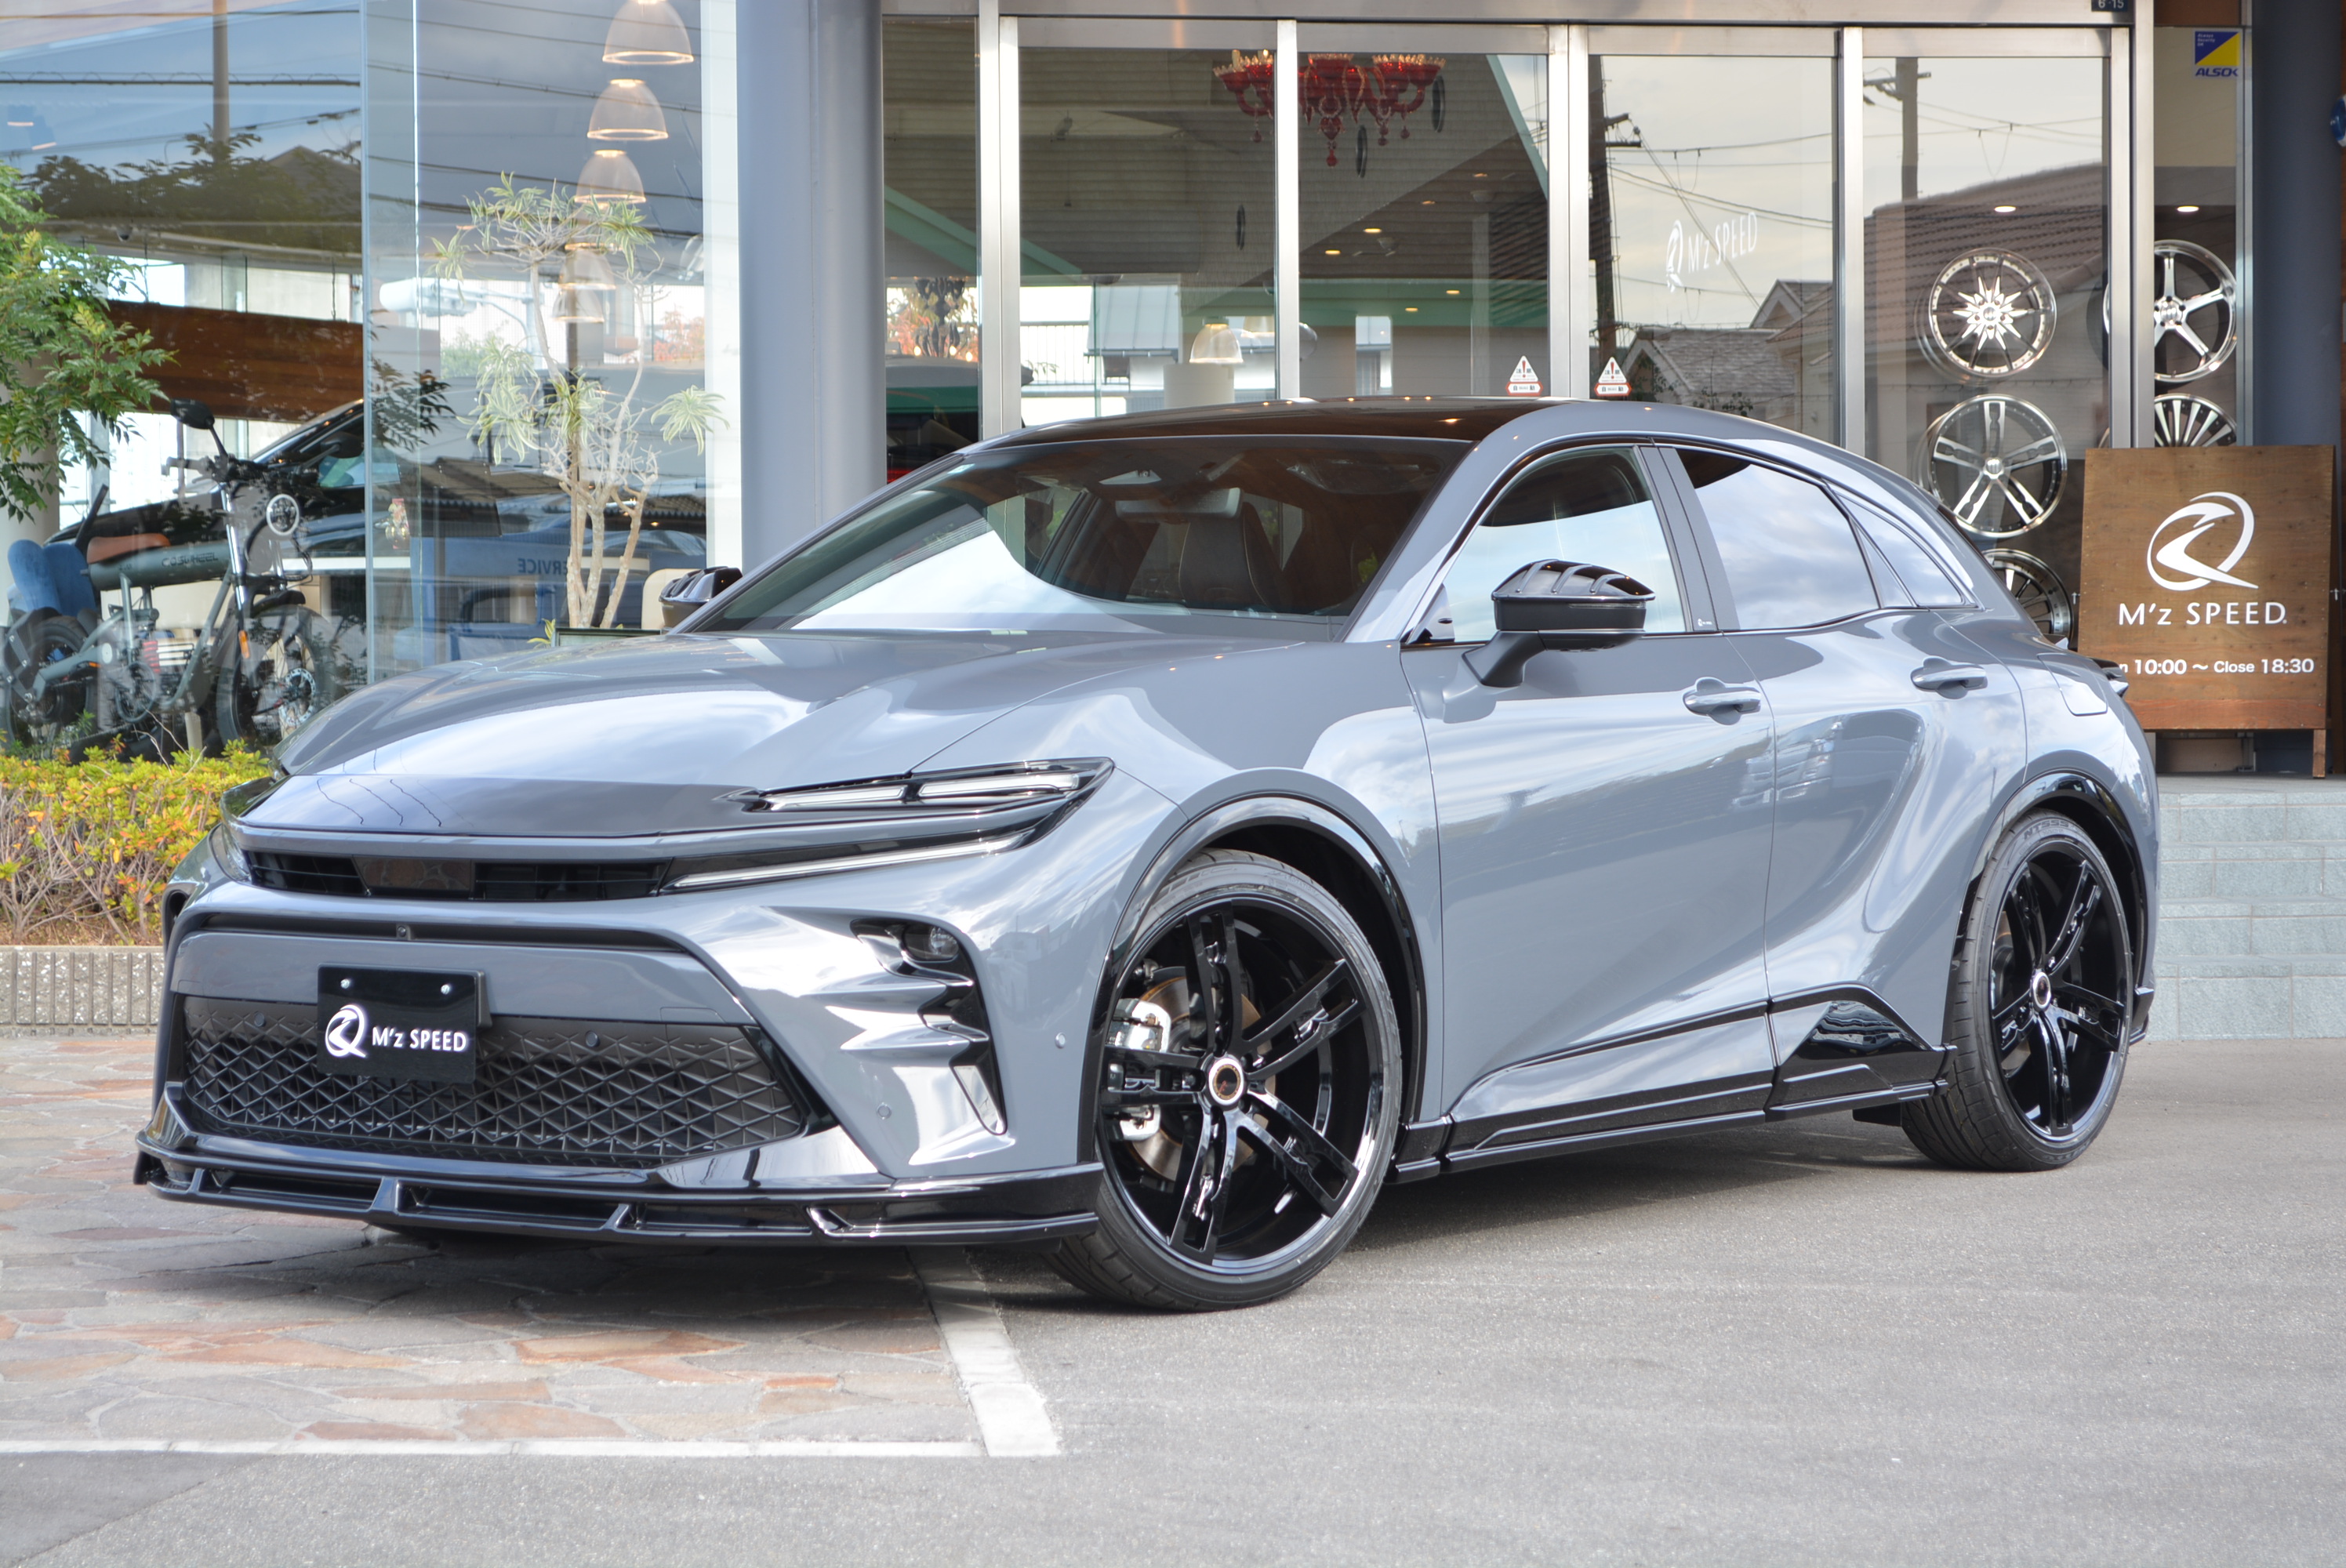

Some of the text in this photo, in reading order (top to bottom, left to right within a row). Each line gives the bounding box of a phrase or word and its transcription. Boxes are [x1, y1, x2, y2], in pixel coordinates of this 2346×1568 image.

[2195, 67, 2238, 77] ALSOK
[1688, 212, 1757, 273] M'z SPEED
[2119, 601, 2286, 626] M'z SPEED
[2134, 659, 2187, 674] 10:00
[2213, 660, 2255, 673] Close
[2261, 658, 2314, 674] 18:30
[372, 1026, 467, 1051] M'z SPEED
